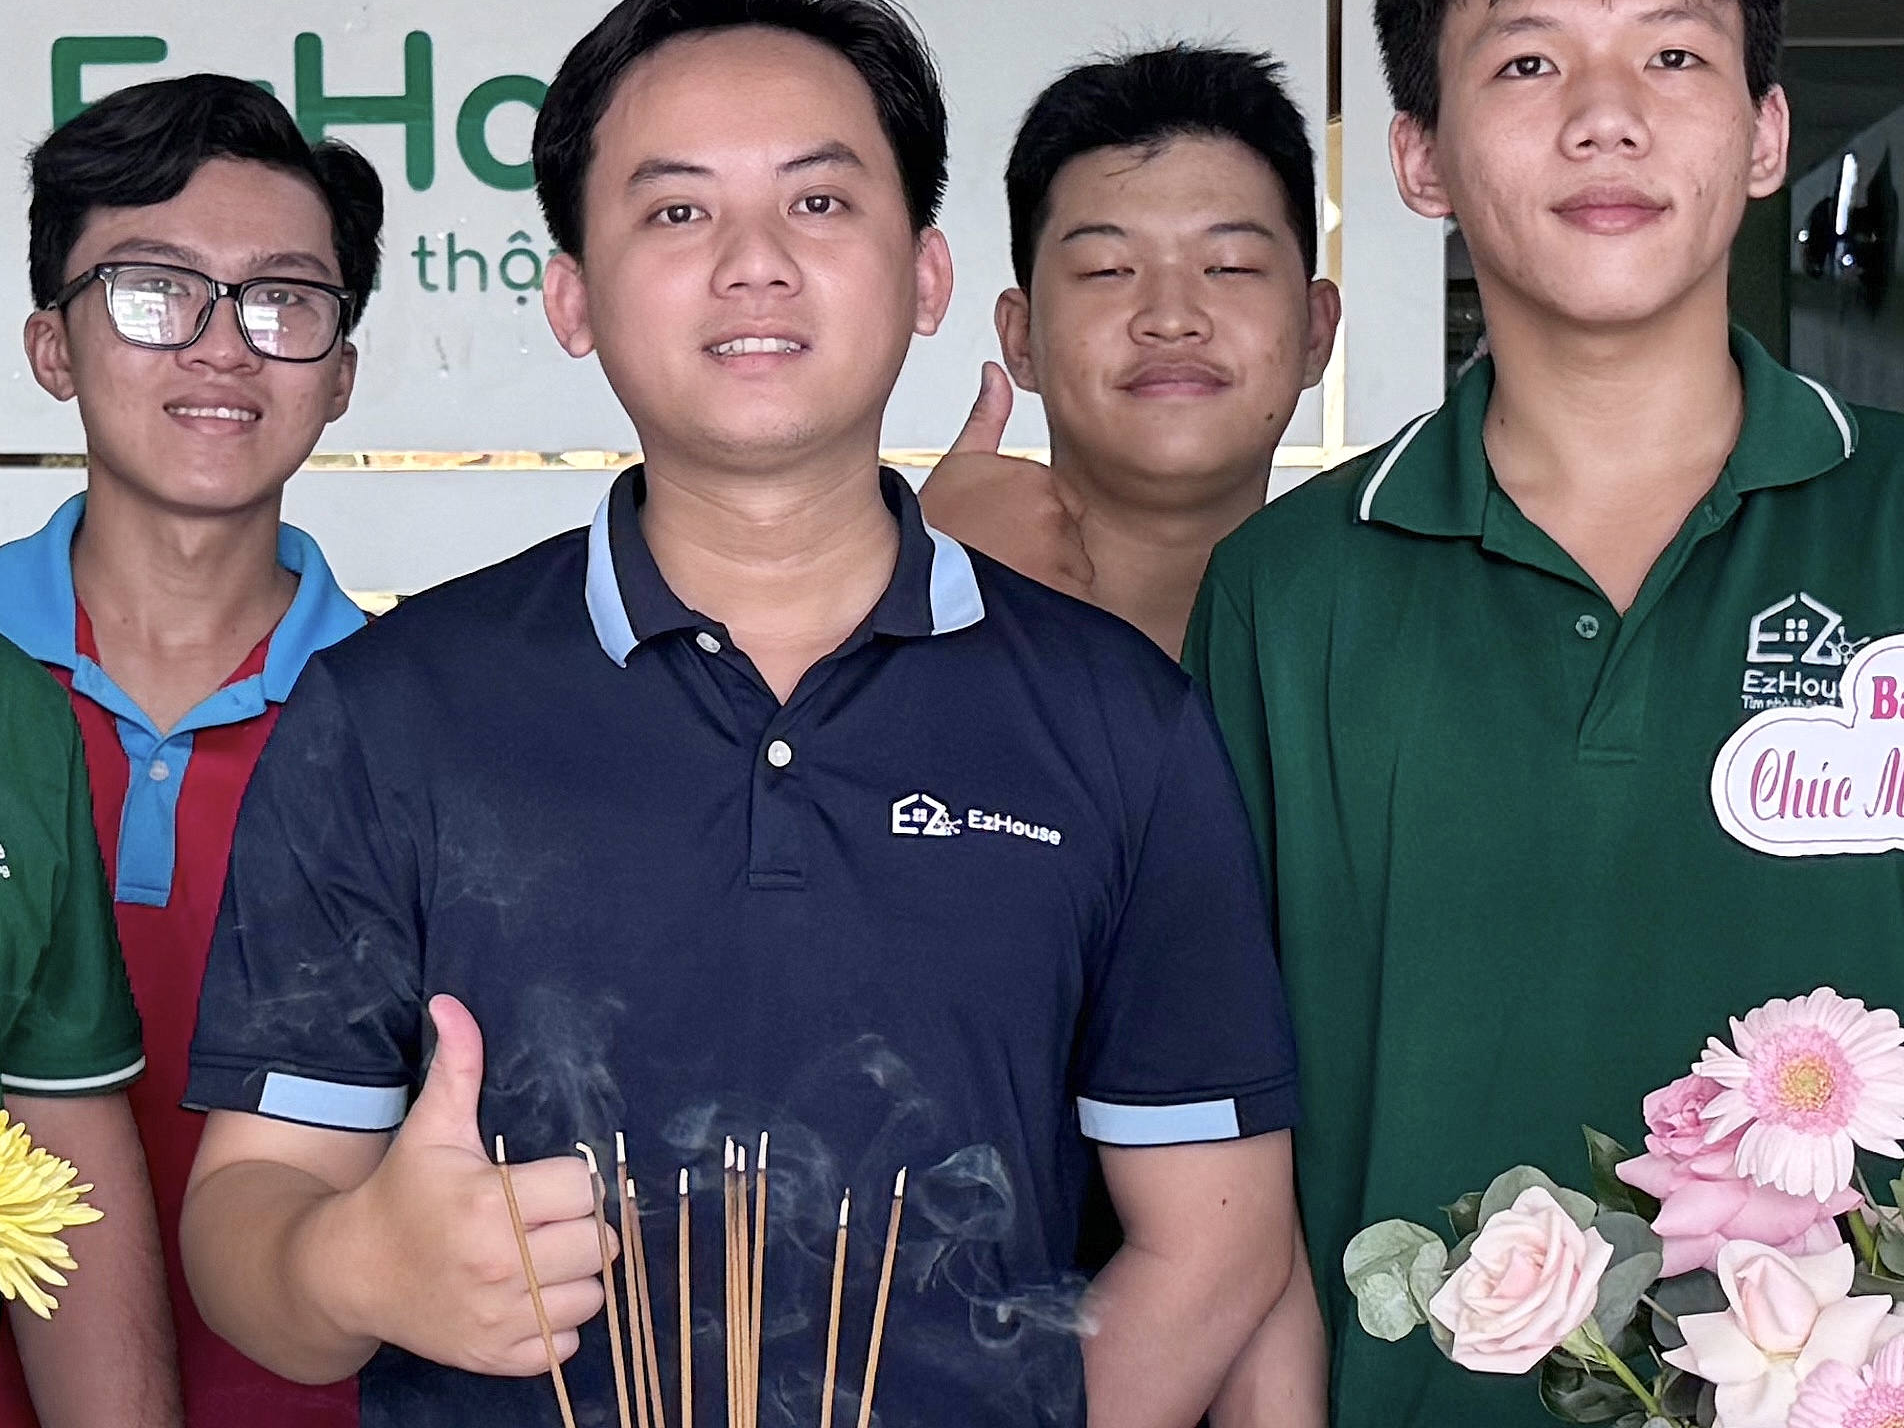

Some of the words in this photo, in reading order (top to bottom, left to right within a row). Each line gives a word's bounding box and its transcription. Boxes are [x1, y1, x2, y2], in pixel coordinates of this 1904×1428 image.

[410, 230, 560, 306] thậ
[1742, 669, 1837, 699] EzHou
[1751, 742, 1853, 821] Chúc
[967, 809, 1062, 845] EzHouse
